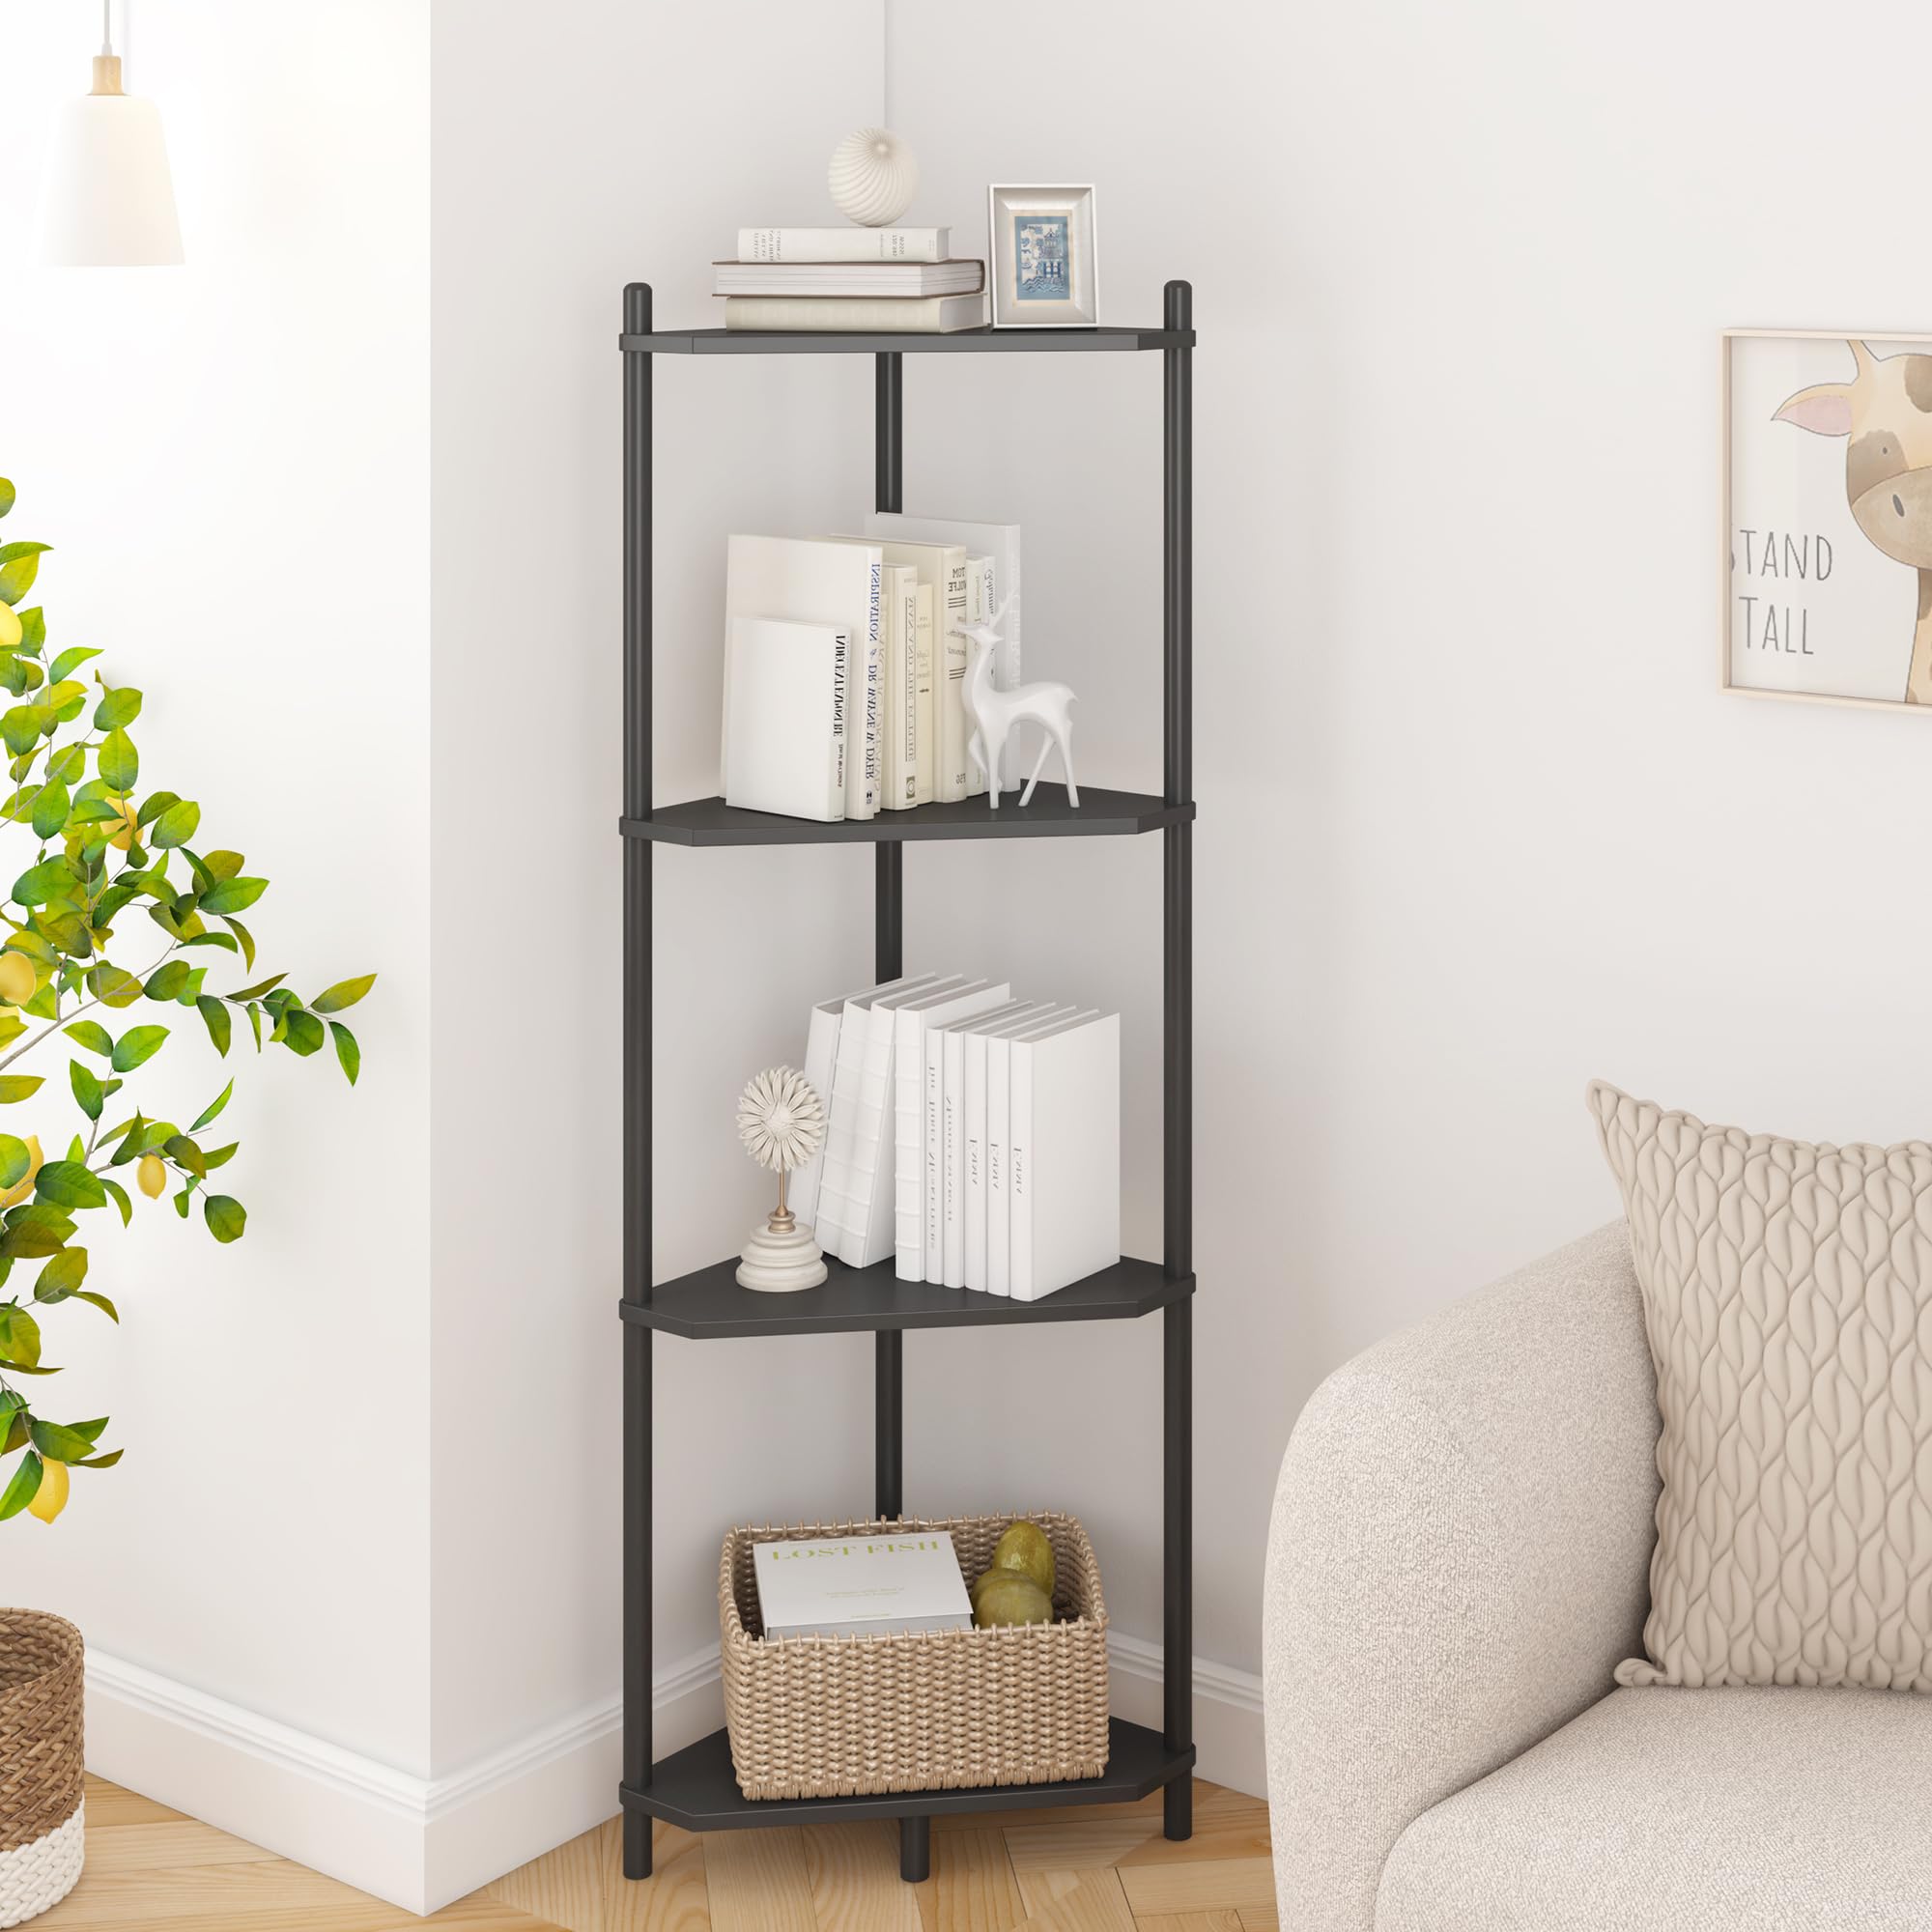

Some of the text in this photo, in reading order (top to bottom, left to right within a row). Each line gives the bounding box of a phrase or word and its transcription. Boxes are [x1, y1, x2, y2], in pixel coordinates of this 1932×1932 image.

[1731, 529, 1833, 581] TAND
[1739, 596, 1814, 655] TALL
[773, 1541, 938, 1560] LOST FISH
